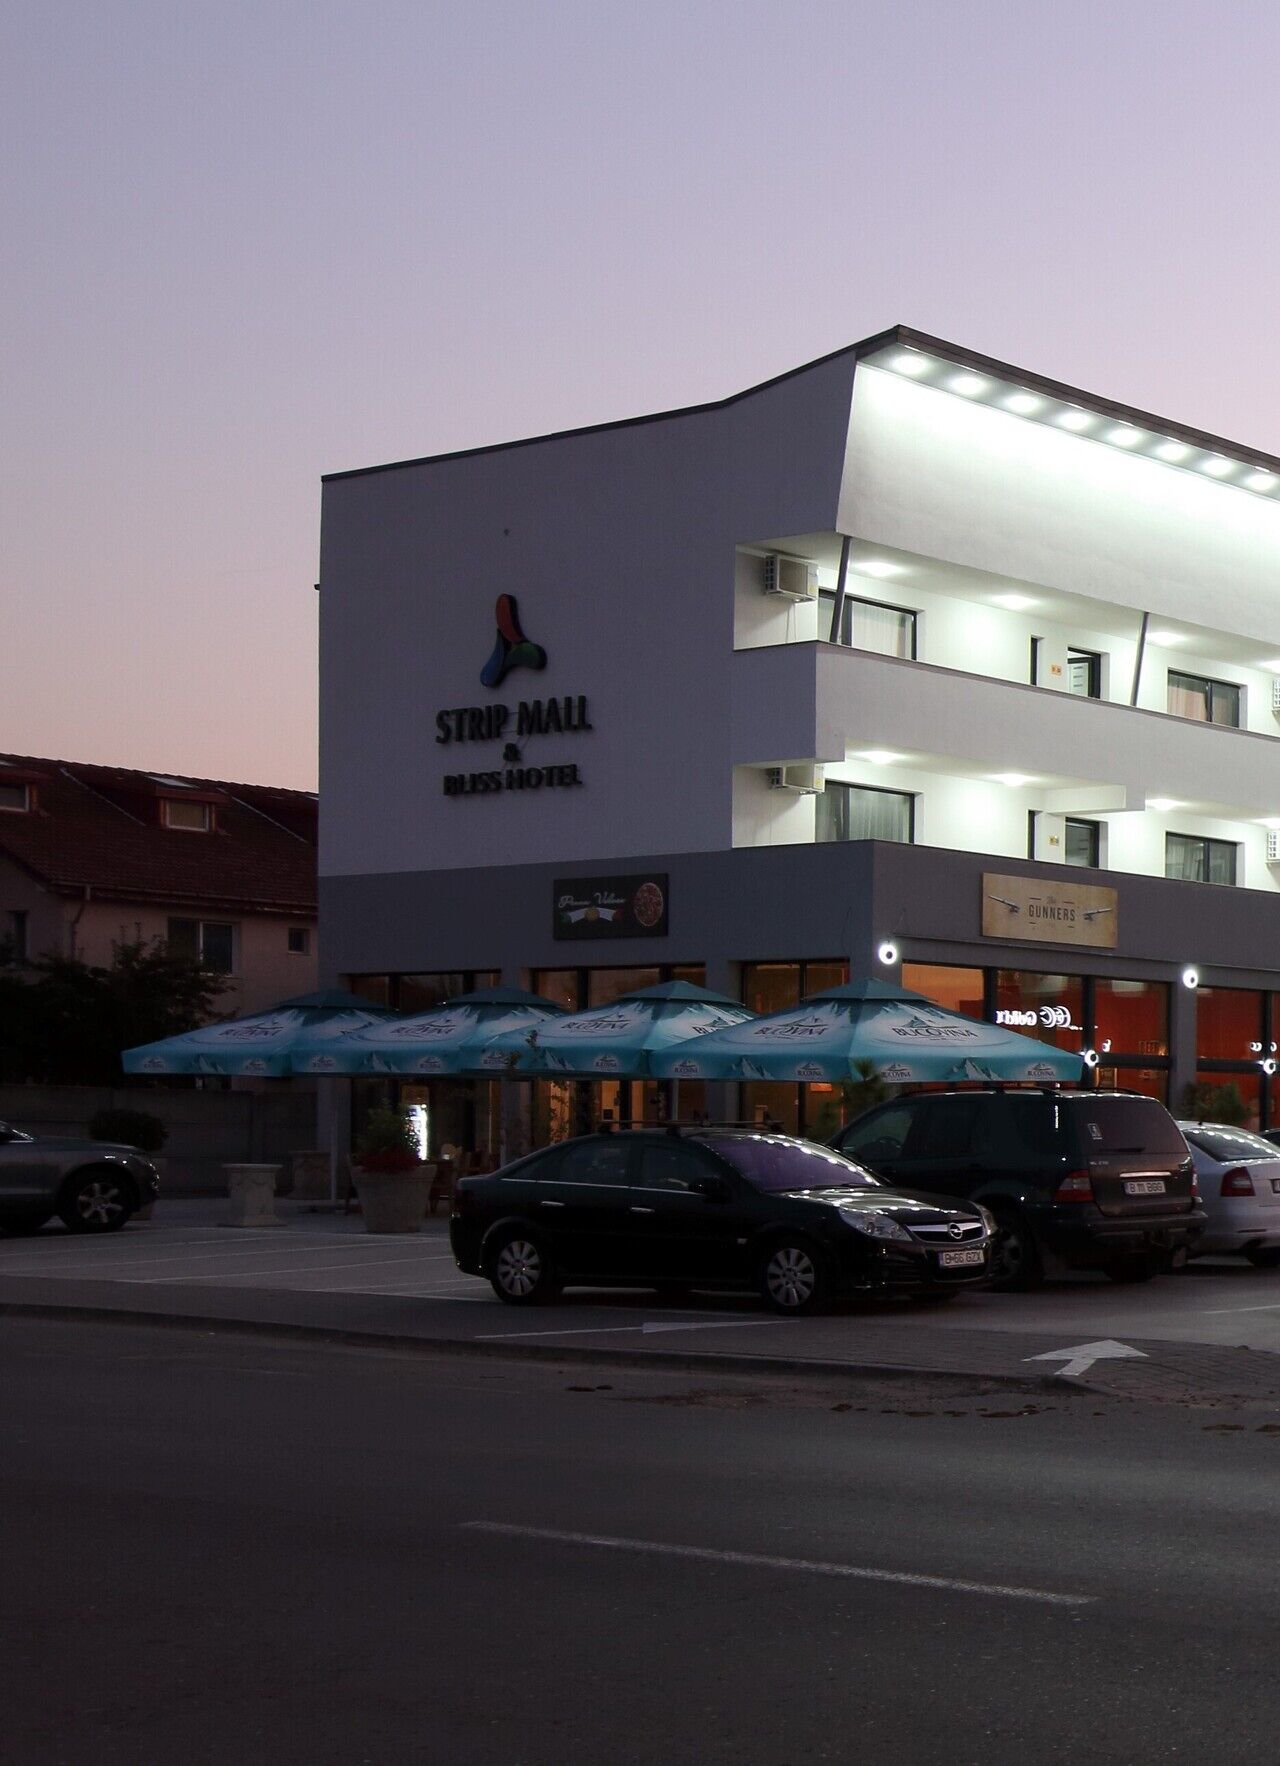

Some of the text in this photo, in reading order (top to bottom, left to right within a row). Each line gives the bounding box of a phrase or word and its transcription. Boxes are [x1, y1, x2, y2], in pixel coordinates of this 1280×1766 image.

[435, 695, 592, 743] STRIP MALL
[503, 743, 521, 761] &
[443, 764, 583, 796] BLISS HOTEL
[1028, 904, 1076, 921] GUNNERS
[892, 1026, 978, 1039] BUCOVINA
